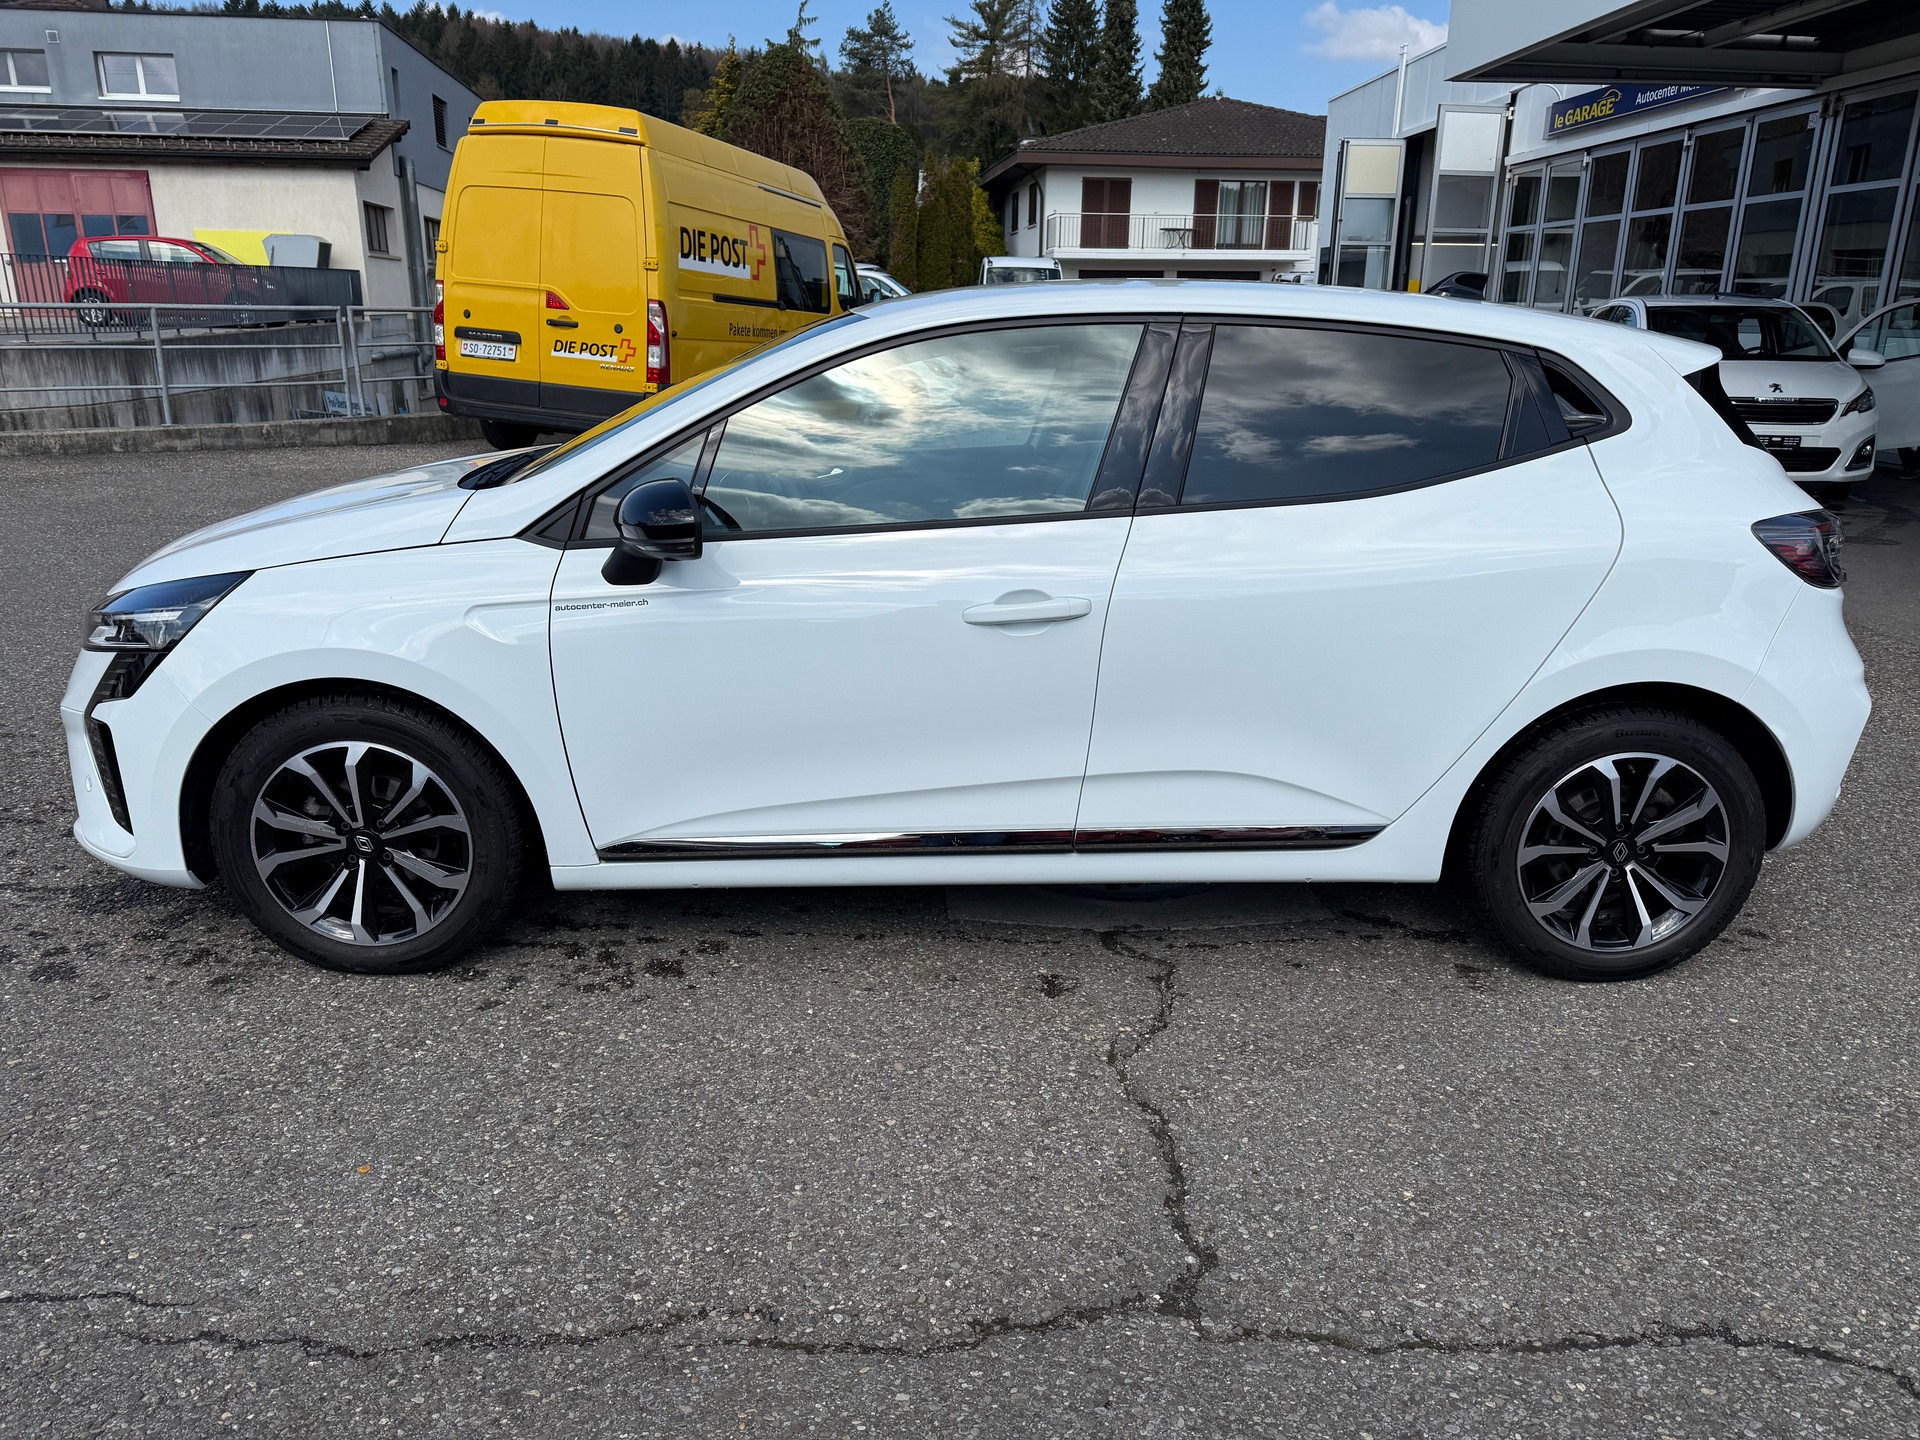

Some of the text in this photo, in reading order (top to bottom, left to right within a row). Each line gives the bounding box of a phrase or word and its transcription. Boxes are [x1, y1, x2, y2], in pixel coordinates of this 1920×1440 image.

[1635, 86, 1680, 105] Autocenter
[1554, 98, 1615, 129] le GARAGE
[680, 226, 748, 269] DIE POST
[729, 322, 751, 338] Pakete
[752, 324, 777, 339] kommen
[553, 339, 618, 357] DIE POST
[600, 363, 636, 372] RENAULT
[555, 599, 649, 611] autocenter-meier.ch
